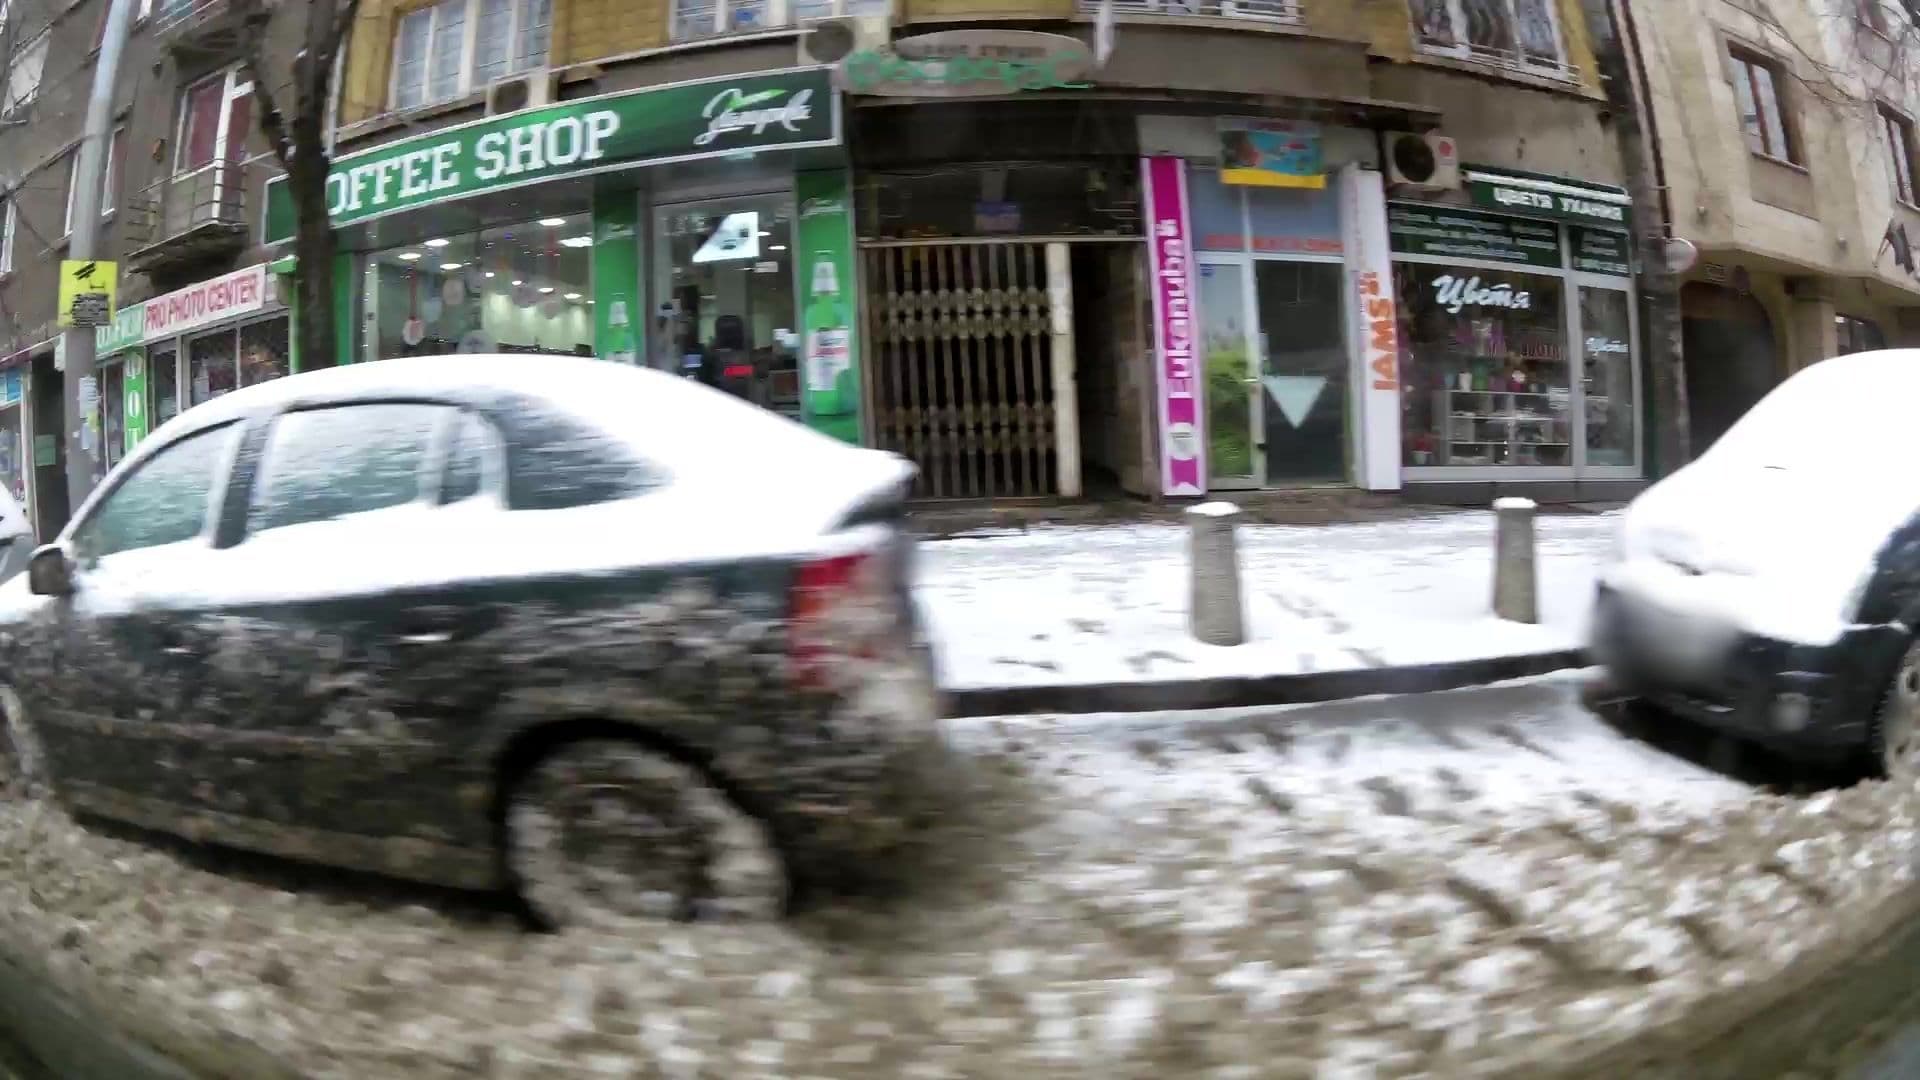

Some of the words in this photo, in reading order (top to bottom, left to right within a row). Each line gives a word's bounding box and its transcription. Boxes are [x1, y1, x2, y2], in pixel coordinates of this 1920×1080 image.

[325, 141, 462, 216] OFFEE
[475, 110, 621, 181] SHOP
[145, 301, 168, 331] PRO
[168, 288, 207, 325] PHOTO
[208, 273, 258, 313] CENTER
[1159, 239, 1193, 399] Eukanuba
[1368, 298, 1397, 392] IAMS
